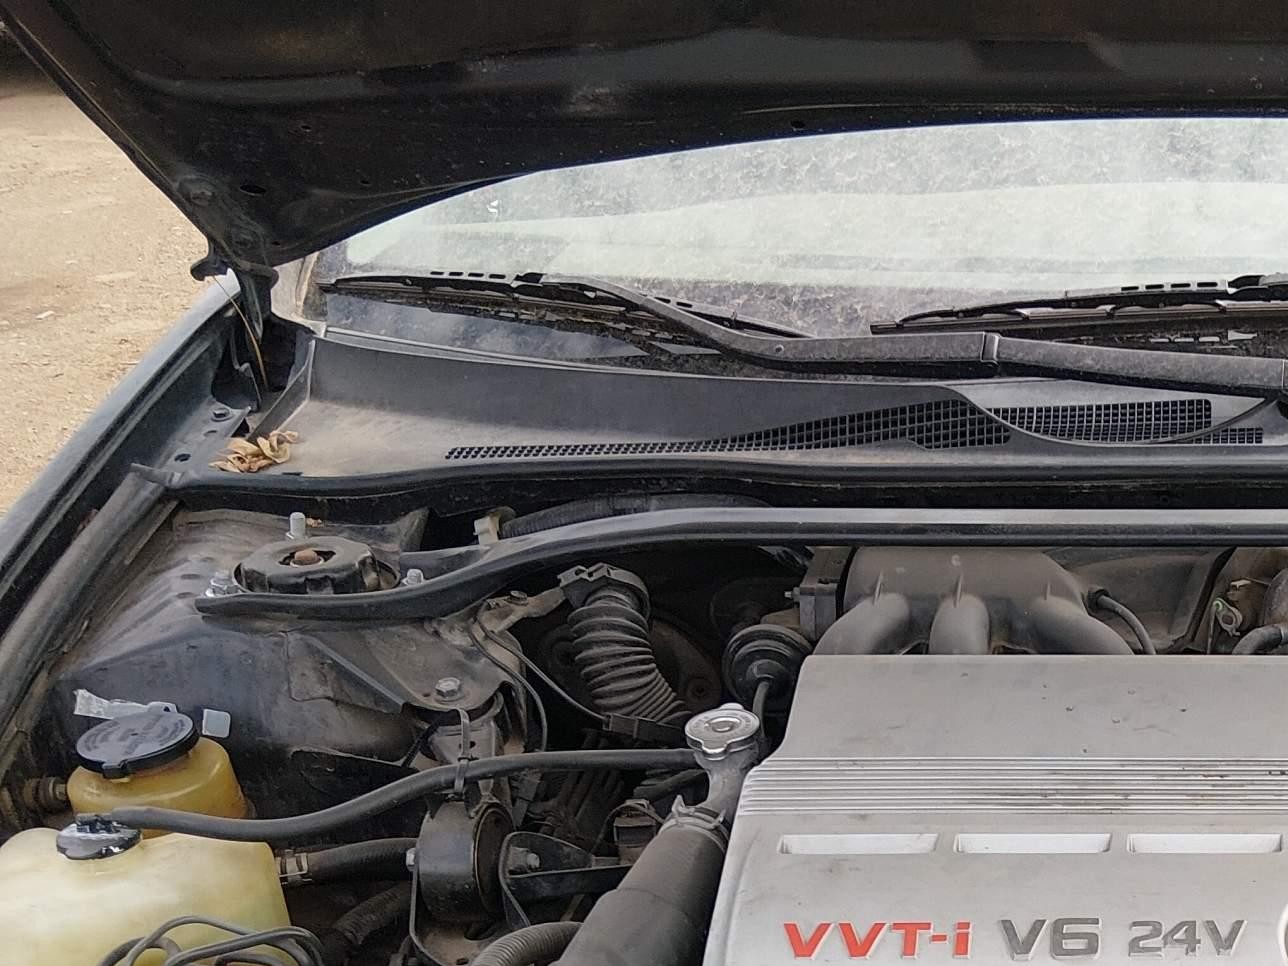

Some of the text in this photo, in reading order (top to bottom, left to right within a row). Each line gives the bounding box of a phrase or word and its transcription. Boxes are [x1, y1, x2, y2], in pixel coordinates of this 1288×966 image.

[783, 917, 1246, 961] VVT-i V6 24V
